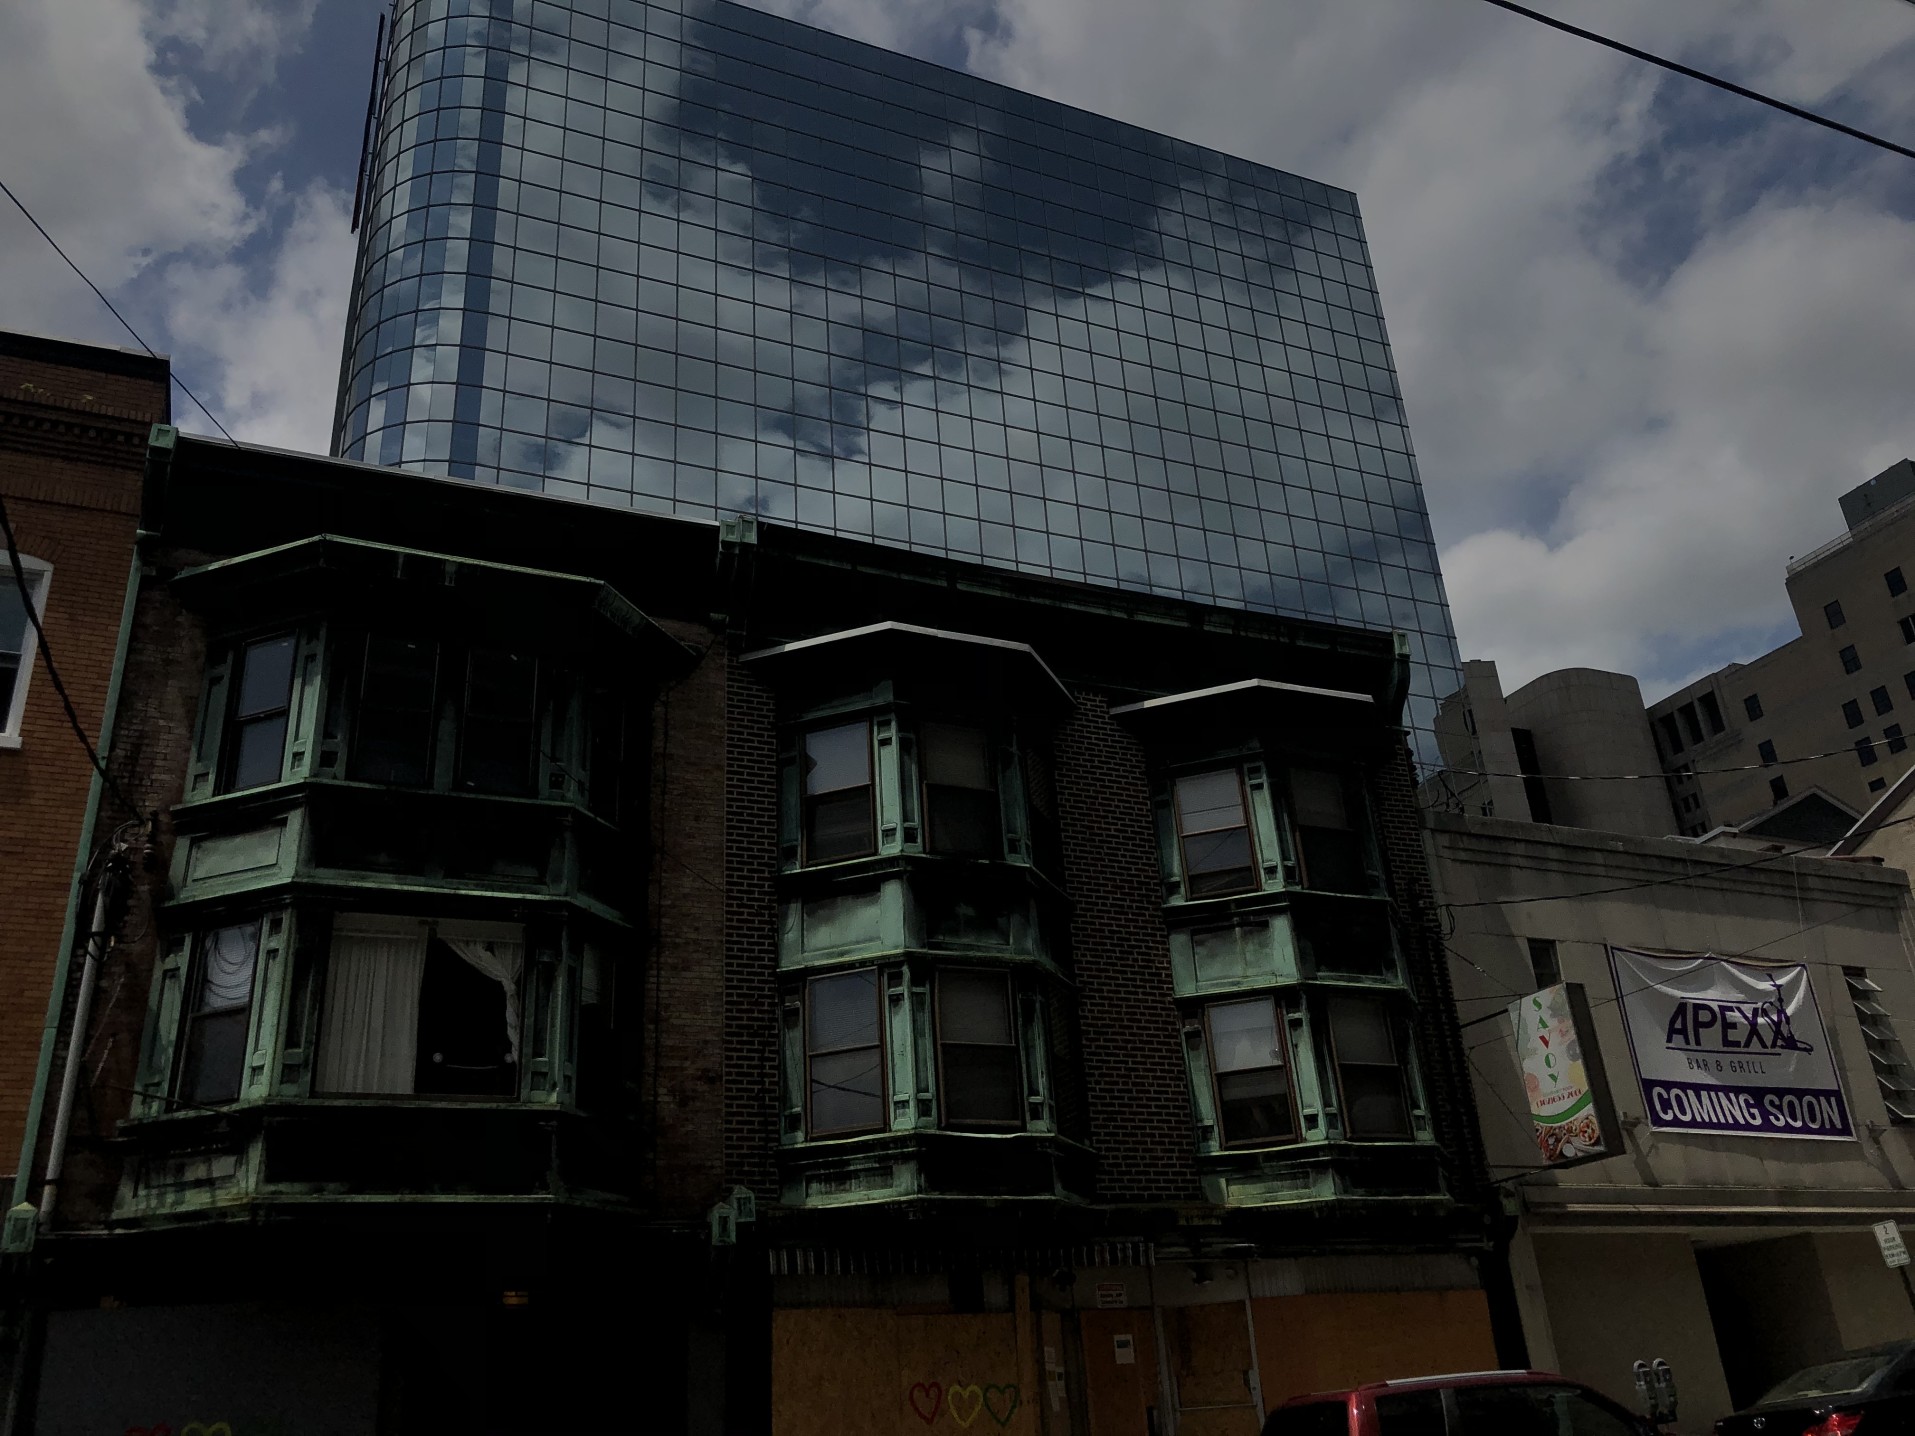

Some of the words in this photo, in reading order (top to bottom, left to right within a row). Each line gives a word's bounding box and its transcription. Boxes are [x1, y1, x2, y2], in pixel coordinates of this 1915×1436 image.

[1532, 996, 1560, 1089] SAVOY
[1666, 1001, 1798, 1050] APEXX
[1687, 1058, 1710, 1072] BAR
[1716, 1060, 1723, 1072] &
[1730, 1060, 1766, 1075] GRILL
[1652, 1086, 1760, 1126] COMING
[1764, 1093, 1843, 1130] SOON
